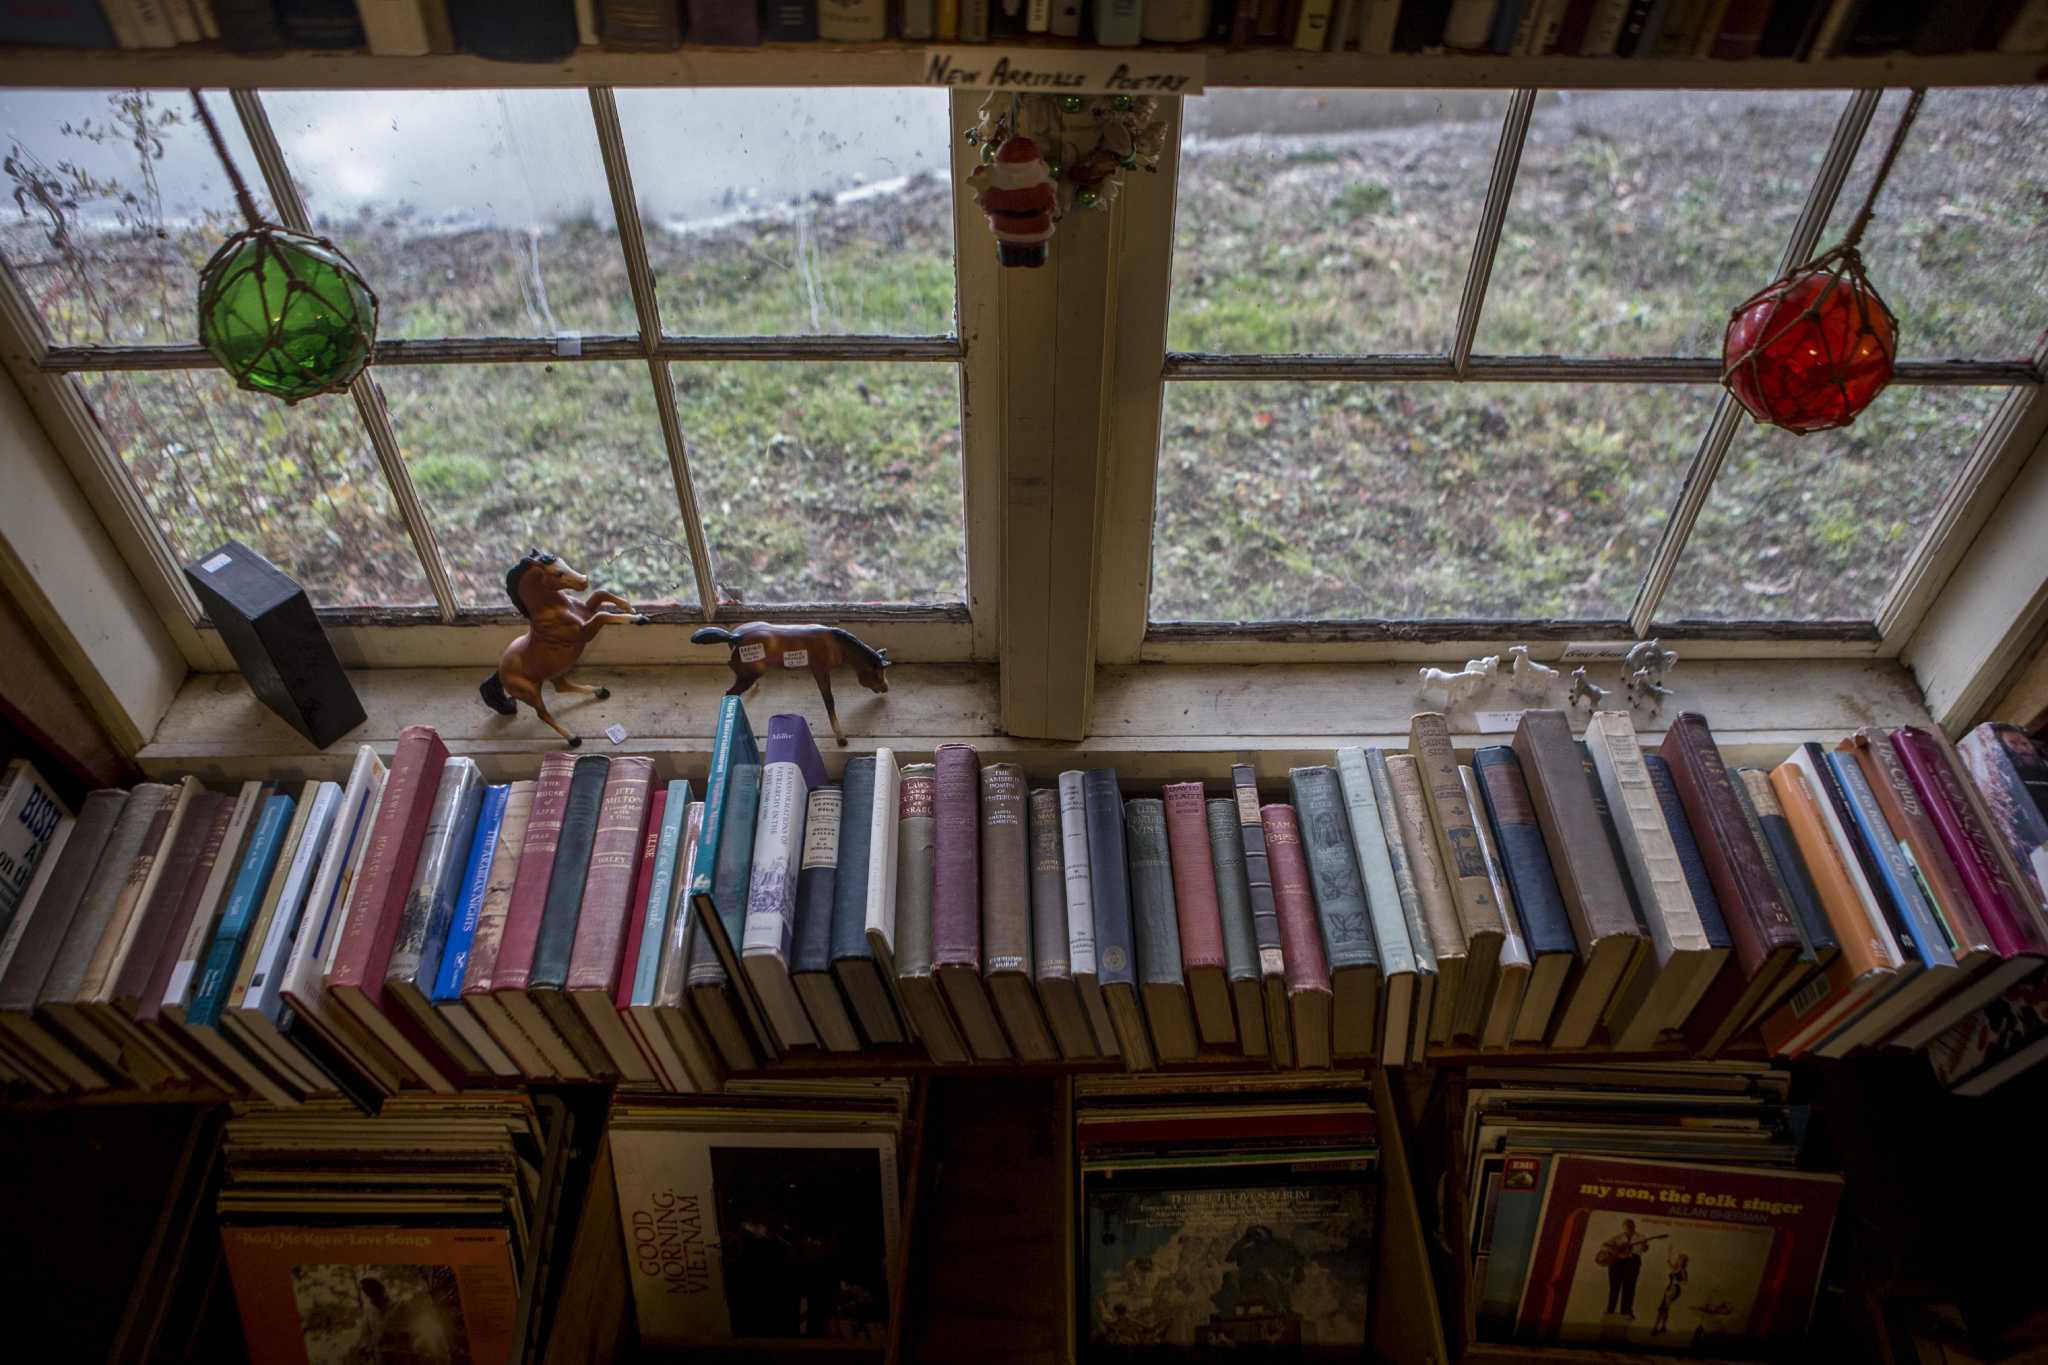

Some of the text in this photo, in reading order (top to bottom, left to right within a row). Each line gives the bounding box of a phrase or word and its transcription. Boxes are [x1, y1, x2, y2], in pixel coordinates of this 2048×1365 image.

[1579, 1183, 1610, 1197] my
[1615, 1187, 1655, 1202] son,
[1659, 1189, 1691, 1204] the
[1696, 1192, 1737, 1209] folk
[1743, 1197, 1804, 1215] singer
[1669, 1207, 1706, 1218] ALLAN
[631, 1210, 661, 1277] GOOD
[651, 1187, 689, 1293] MORNING,
[676, 1194, 711, 1294] VIETNAM
